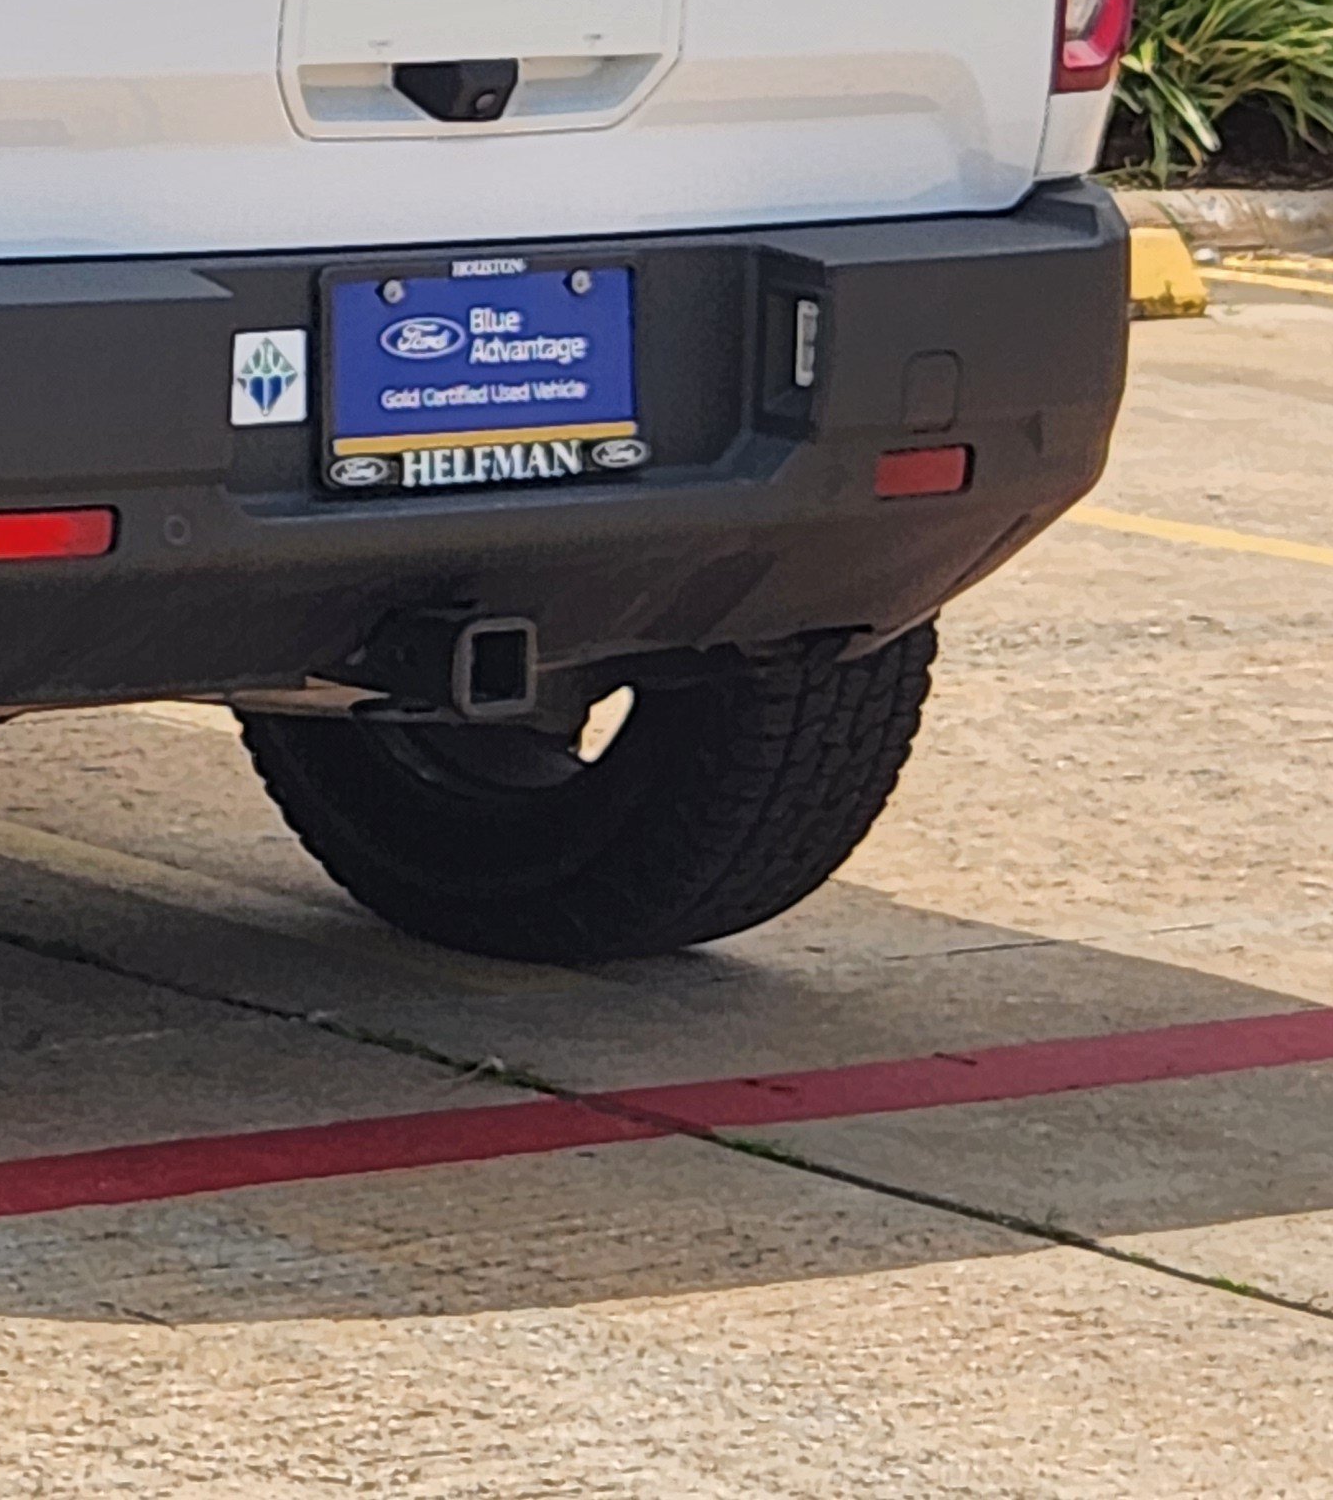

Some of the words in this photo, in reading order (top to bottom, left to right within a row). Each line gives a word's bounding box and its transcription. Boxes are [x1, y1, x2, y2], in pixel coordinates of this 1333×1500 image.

[469, 307, 522, 334] Blue
[397, 324, 453, 350] Ford
[469, 336, 588, 365] Advantage
[381, 387, 421, 410] Gold
[422, 383, 489, 407] Certified
[490, 381, 530, 404] Used
[531, 378, 588, 401] Vehicle
[401, 440, 583, 487] HELFMAN
